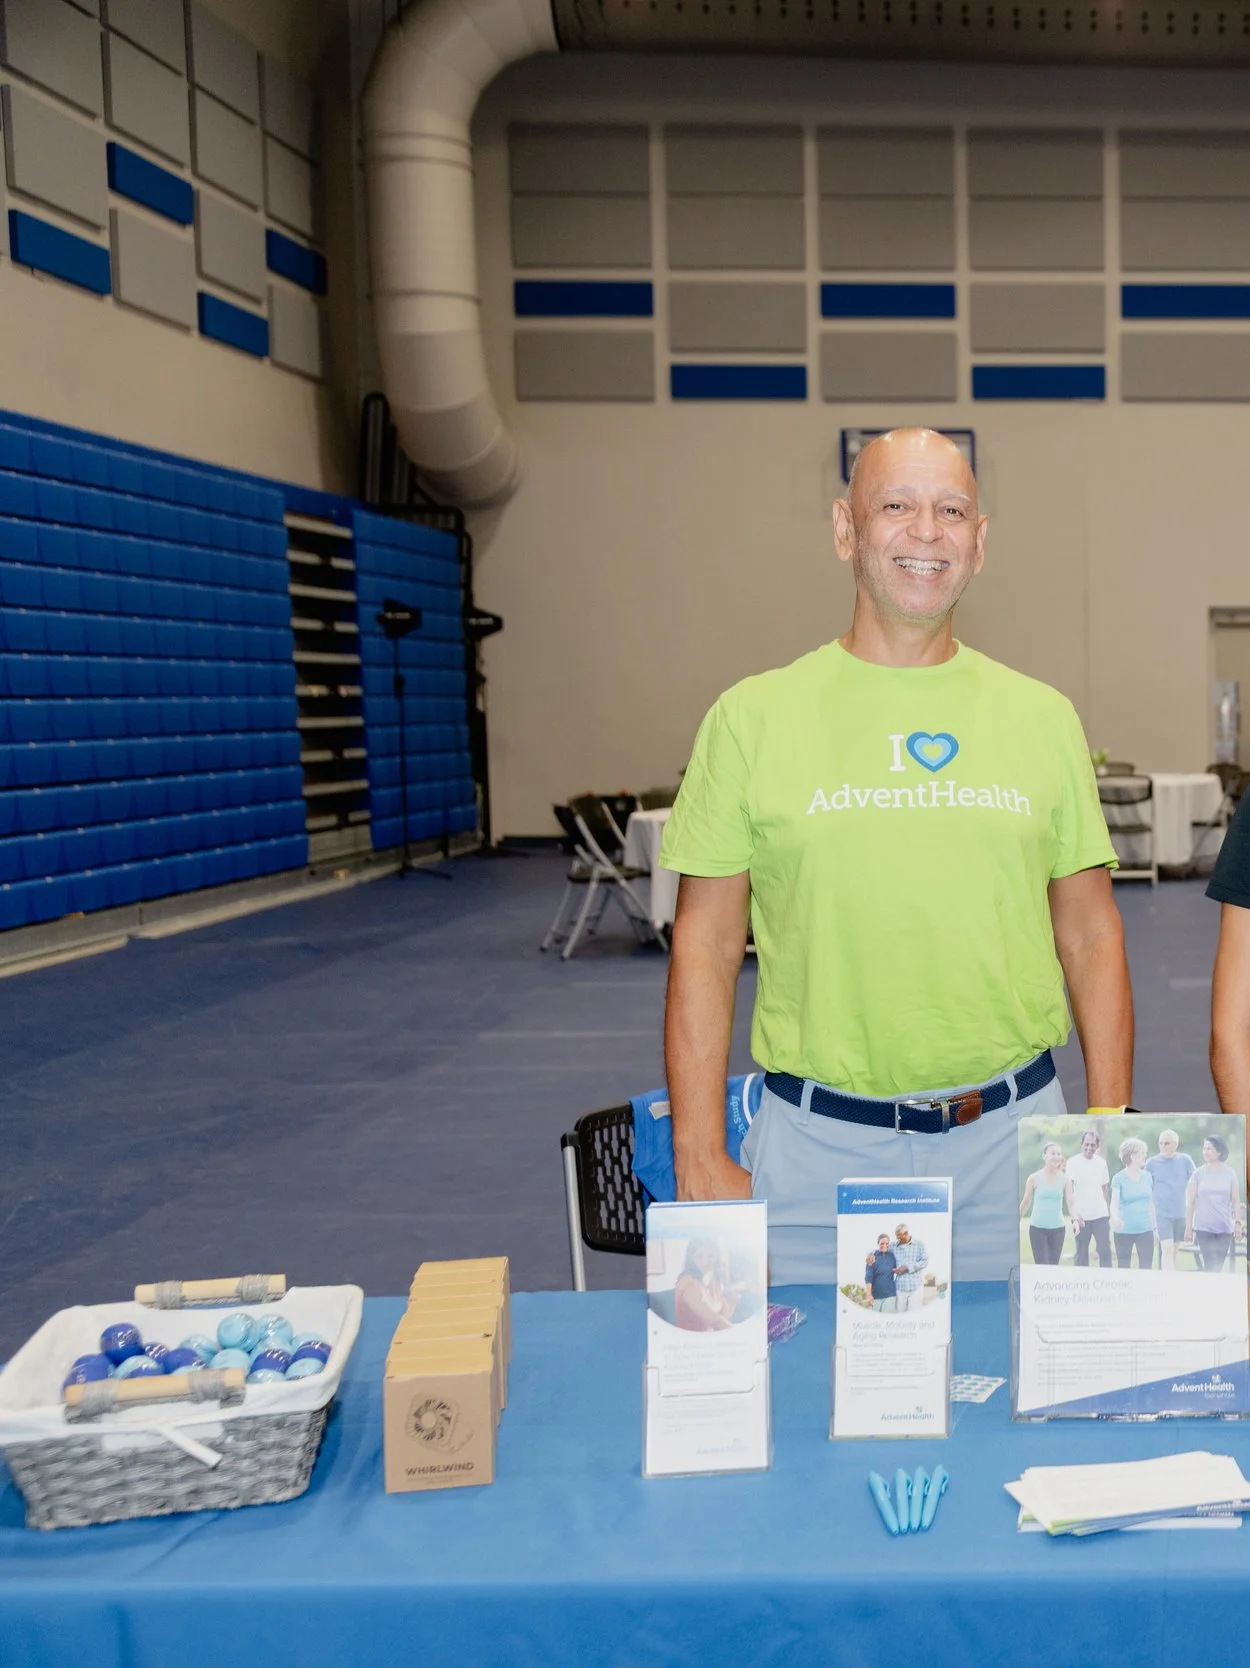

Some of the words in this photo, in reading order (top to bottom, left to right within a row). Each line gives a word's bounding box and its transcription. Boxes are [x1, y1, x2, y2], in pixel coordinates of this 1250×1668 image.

[888, 734, 906, 772] I
[806, 780, 1031, 816] AdventHealth
[730, 1095, 742, 1124] Study
[1034, 1280, 1090, 1292] Advancing
[1034, 1294, 1069, 1305] Kidney
[1171, 1382, 1235, 1393] AdventHealth
[881, 1411, 934, 1421] AdventHealth
[405, 1462, 475, 1476] WHIRLWIND
